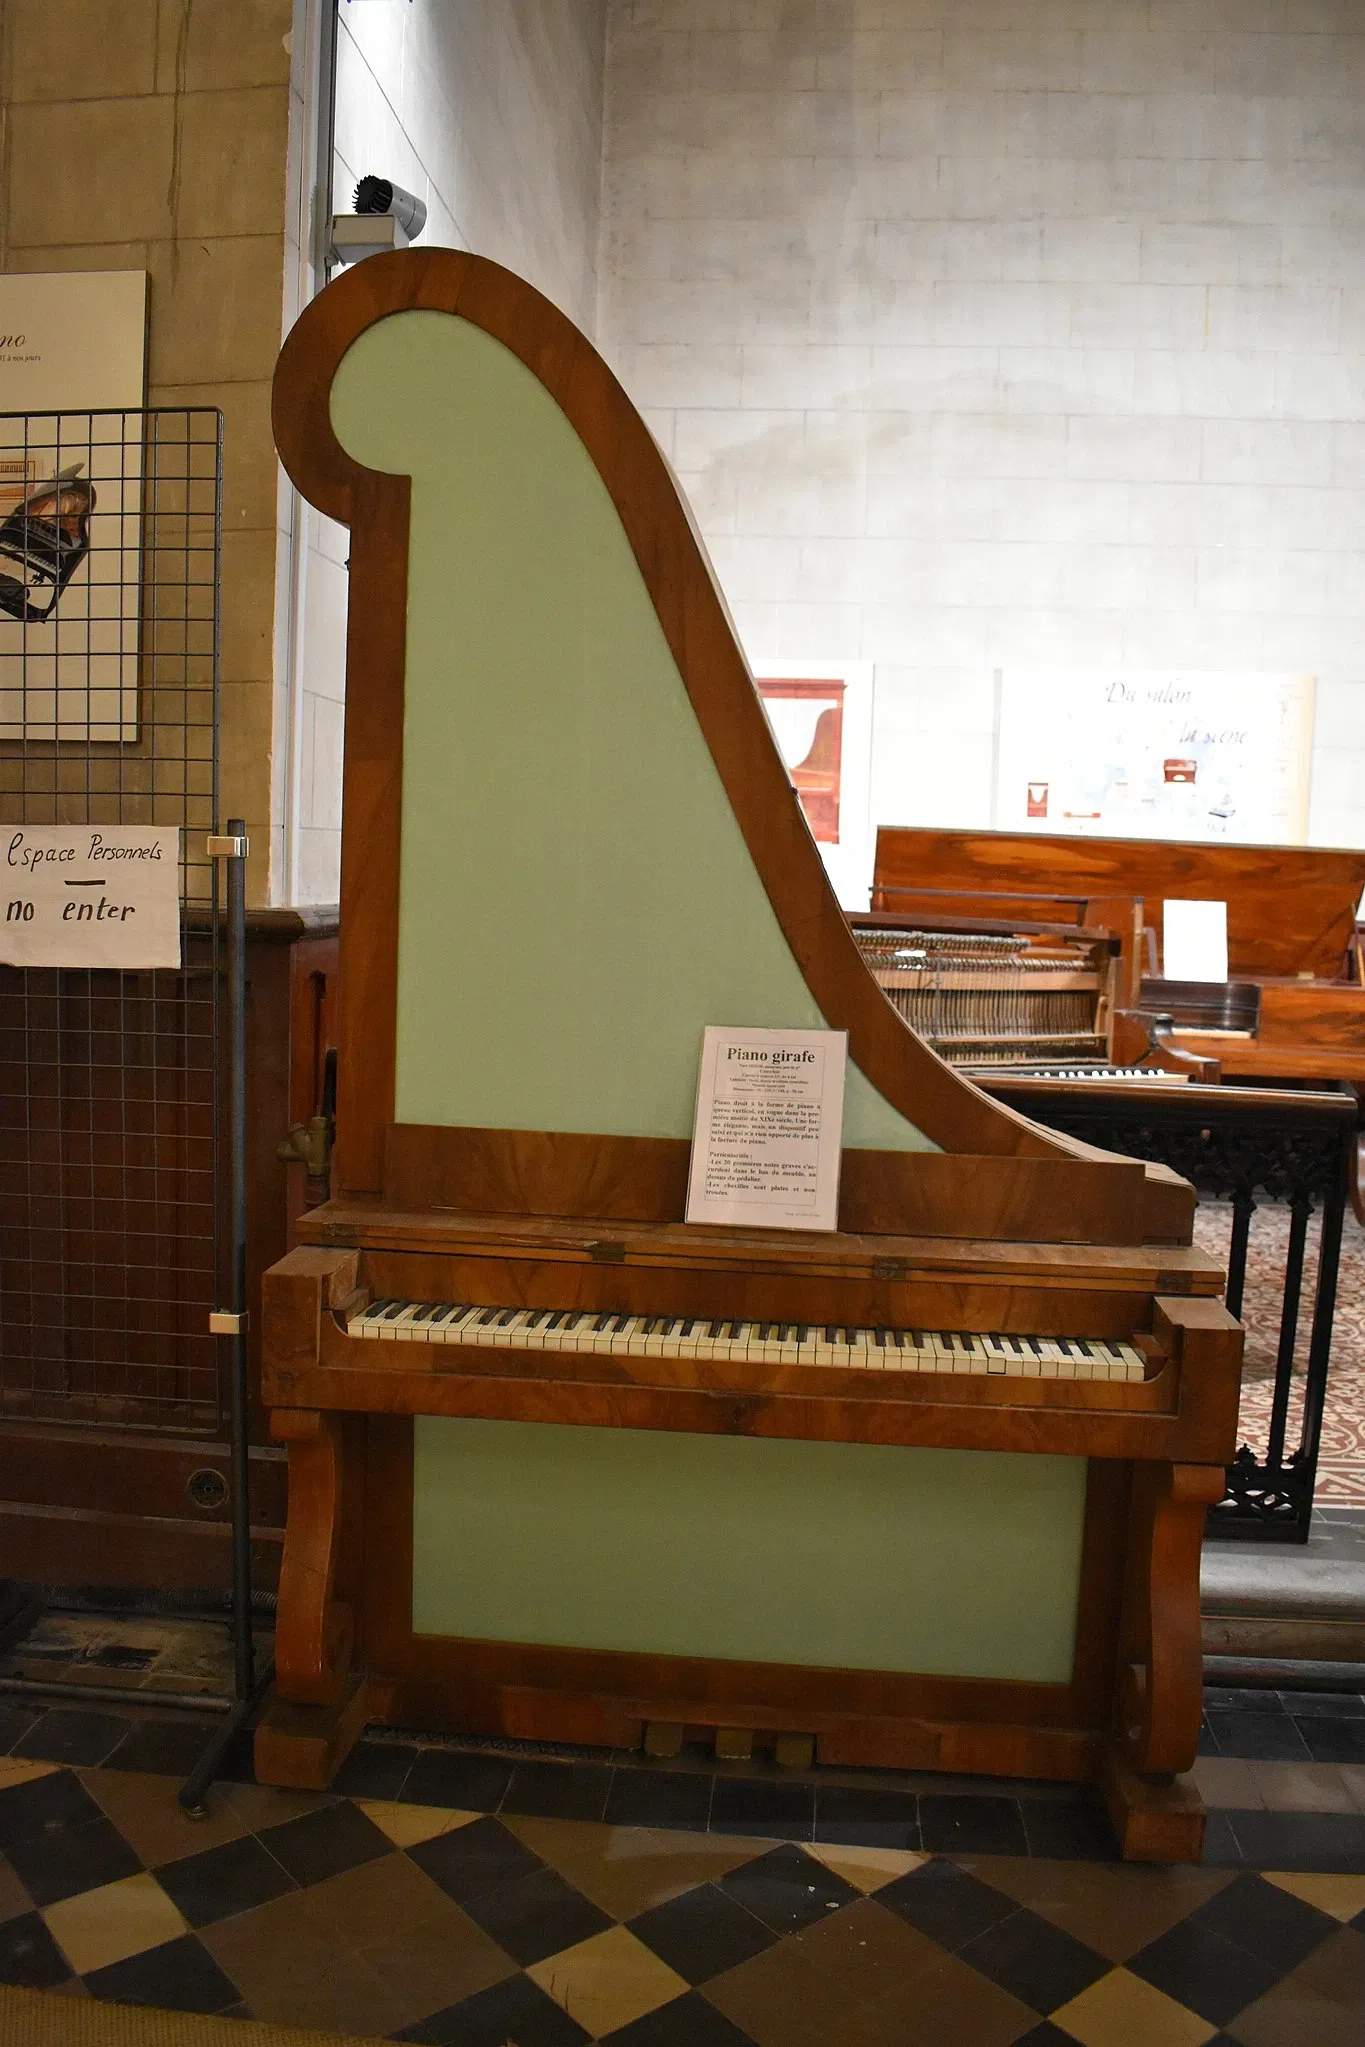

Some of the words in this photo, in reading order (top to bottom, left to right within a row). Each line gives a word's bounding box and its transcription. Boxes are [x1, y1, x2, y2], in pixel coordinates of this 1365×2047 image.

[25, 354, 41, 362] jours
[87, 834, 162, 860] Personnels
[6, 900, 34, 921] no
[62, 897, 136, 921] enter
[728, 1048, 768, 1061] Piano
[772, 1050, 815, 1064] girafe
